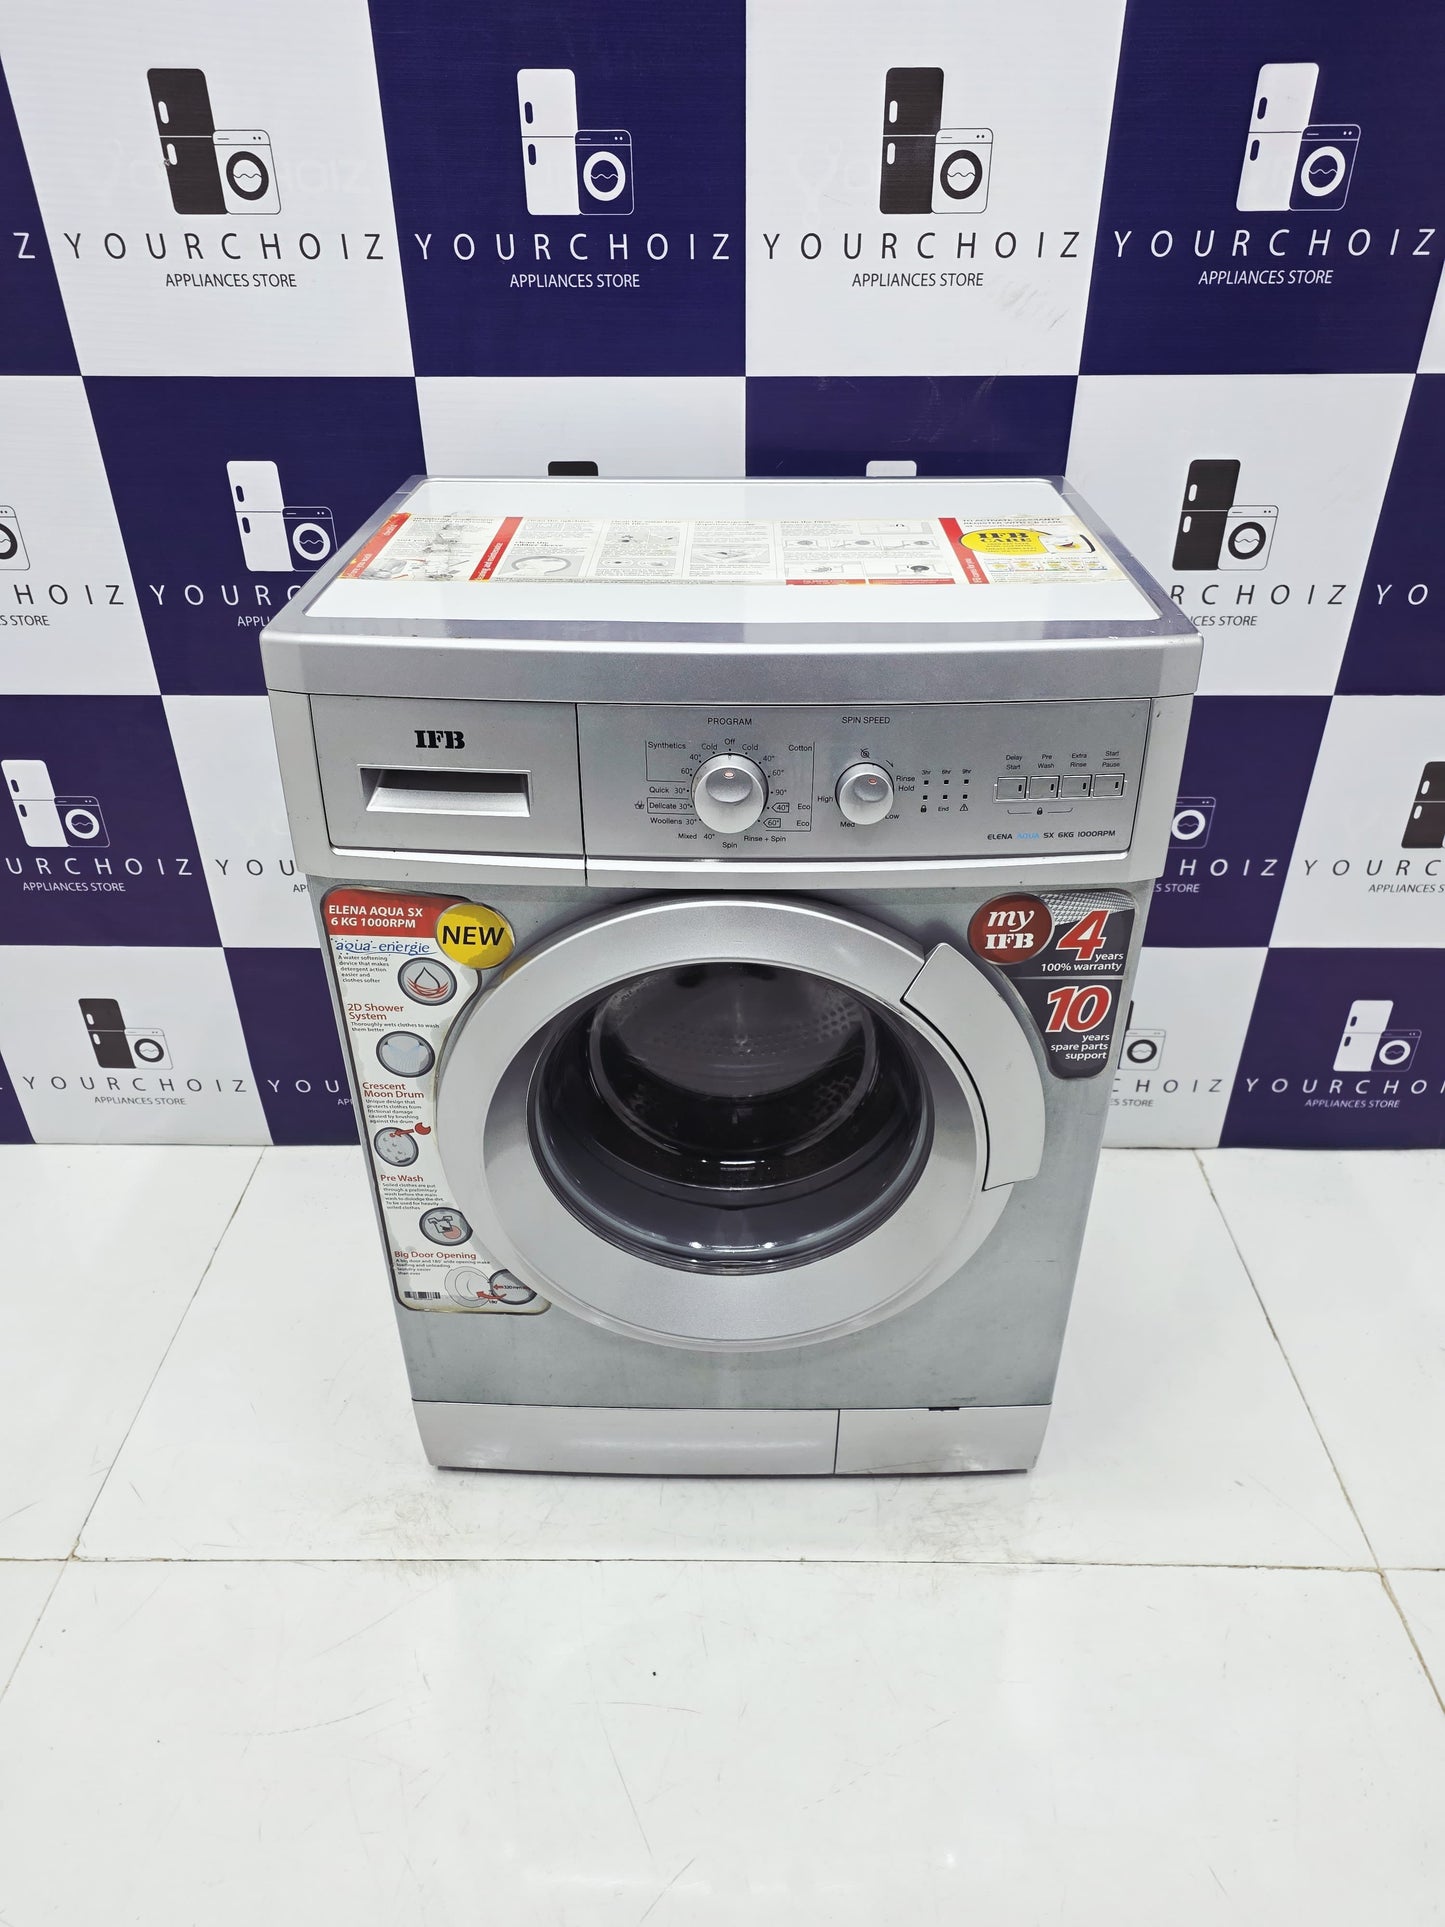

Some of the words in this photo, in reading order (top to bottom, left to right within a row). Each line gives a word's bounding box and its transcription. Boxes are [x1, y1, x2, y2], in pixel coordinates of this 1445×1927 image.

[165, 273, 250, 288] APPLIANCES
[252, 273, 297, 288] STORE
[509, 273, 594, 288] APPLIANCES
[596, 273, 641, 288] STORE
[851, 273, 936, 287] APPLIANCES
[939, 272, 984, 287] STORE
[1198, 269, 1285, 285] APPLIANCES
[1287, 269, 1334, 284] STORE
[10, 614, 50, 626] STORE
[1218, 615, 1258, 626] STORE
[707, 717, 752, 726] PROGRAM
[842, 716, 861, 725] SPIN
[863, 717, 891, 725] SPEED
[414, 730, 466, 749] IFB
[648, 742, 687, 750] Synthetics
[701, 743, 718, 751] Cold
[742, 743, 759, 751] Cold
[788, 744, 813, 752] Cotton
[1005, 754, 1023, 762] Delay
[649, 786, 670, 795] Quick
[817, 795, 834, 803] High
[649, 802, 677, 810] Delicate
[797, 803, 811, 811] Eco
[650, 817, 683, 825] Woollens
[1077, 830, 1116, 838] 1000RPM
[770, 836, 787, 844] Spin
[722, 842, 738, 850] Spin
[23, 882, 88, 892] APPLIANCES
[90, 883, 126, 892] STORE
[1164, 883, 1200, 893] STORE
[1368, 883, 1436, 893] APPLIANCES
[329, 904, 367, 915] ELENA
[369, 906, 405, 917] AQUA
[407, 907, 423, 917] SX
[331, 917, 339, 926] 6
[341, 917, 358, 927] KG
[361, 918, 416, 928] 1000RPM
[987, 910, 1035, 933] my
[442, 925, 505, 946] NEW
[1056, 909, 1110, 961] 4
[984, 933, 1035, 950] IFB
[1094, 953, 1124, 962] years
[1041, 963, 1072, 972] 100%
[1074, 962, 1122, 972] warranty
[347, 1003, 362, 1012] 2D
[364, 1004, 404, 1012] Shower
[1045, 985, 1112, 1032] 10
[348, 1011, 387, 1021] System
[1082, 1034, 1110, 1043] years
[1051, 1043, 1079, 1052] spare
[1081, 1043, 1108, 1052] parts
[1065, 1052, 1107, 1061] support
[362, 1082, 406, 1090] Crescent
[364, 1090, 394, 1098] Moon
[94, 1096, 153, 1105] APPLIANCES
[154, 1097, 186, 1106] STORE
[1122, 1099, 1154, 1107] STORE
[1305, 1099, 1367, 1108] APPLIANCES
[1368, 1100, 1400, 1108] STORE
[380, 1174, 396, 1182] Pre
[397, 1174, 424, 1182] Wash
[394, 1251, 409, 1259] Big
[436, 1252, 477, 1260] Opening
